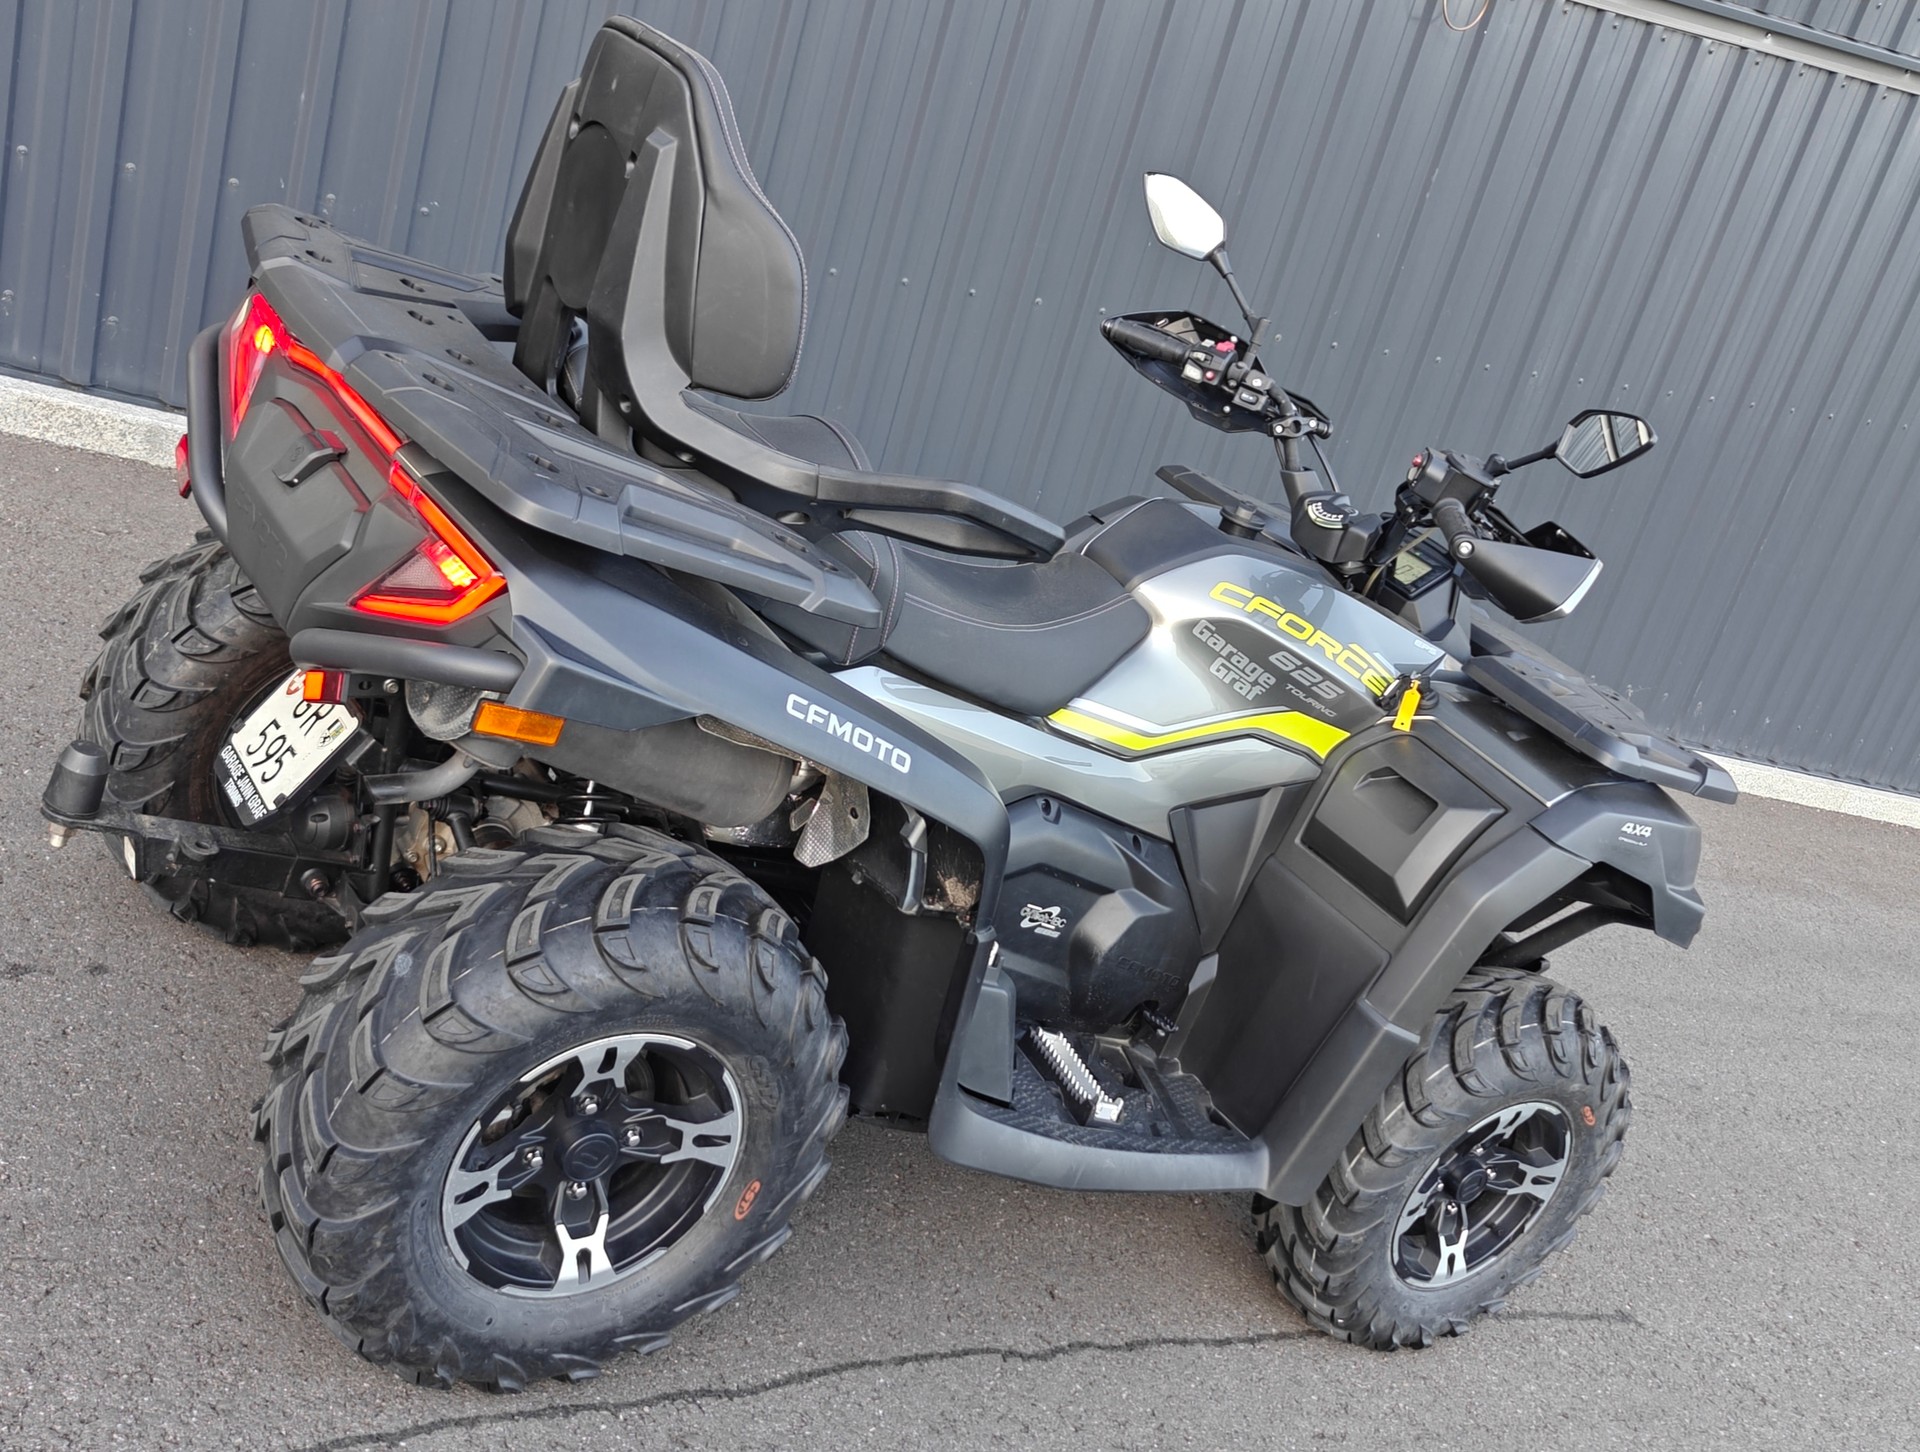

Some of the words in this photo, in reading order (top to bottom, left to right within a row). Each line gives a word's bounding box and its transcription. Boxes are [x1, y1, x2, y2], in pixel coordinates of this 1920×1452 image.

[1192, 619, 1276, 691] Garage
[1208, 580, 1395, 697] CFORCE
[1209, 656, 1267, 701] Graf
[1268, 651, 1345, 700] 625
[1284, 683, 1338, 718] TOURING
[246, 718, 298, 784] 595
[786, 693, 912, 774] CFMOTO
[221, 745, 245, 781] GARAGE
[236, 774, 256, 801] JANN
[247, 794, 268, 819] GRAF
[1621, 822, 1653, 838] 4X4
